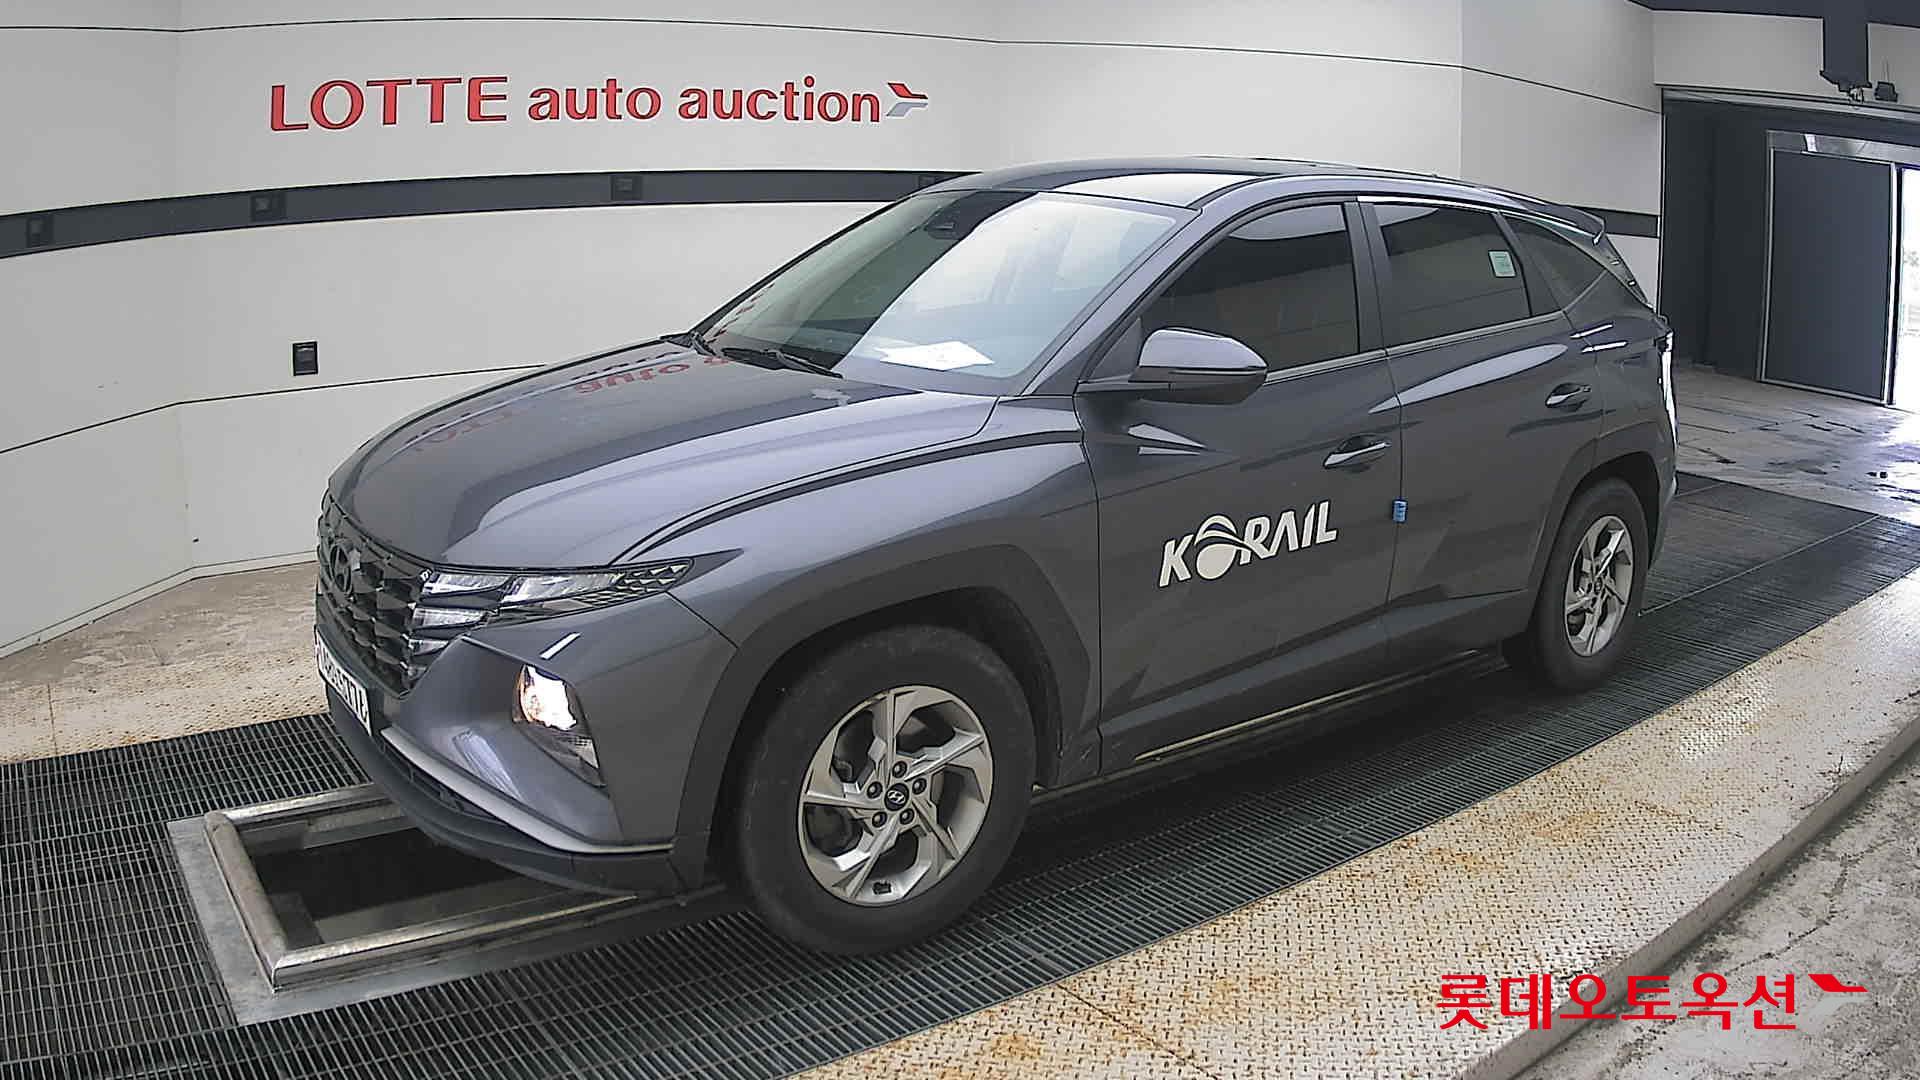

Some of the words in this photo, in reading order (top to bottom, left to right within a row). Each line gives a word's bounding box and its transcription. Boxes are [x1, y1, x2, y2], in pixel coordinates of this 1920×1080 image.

[270, 76, 508, 132] LOTTE
[528, 78, 662, 121] auto
[678, 75, 880, 123] auction
[1159, 500, 1338, 588] KORAIL
